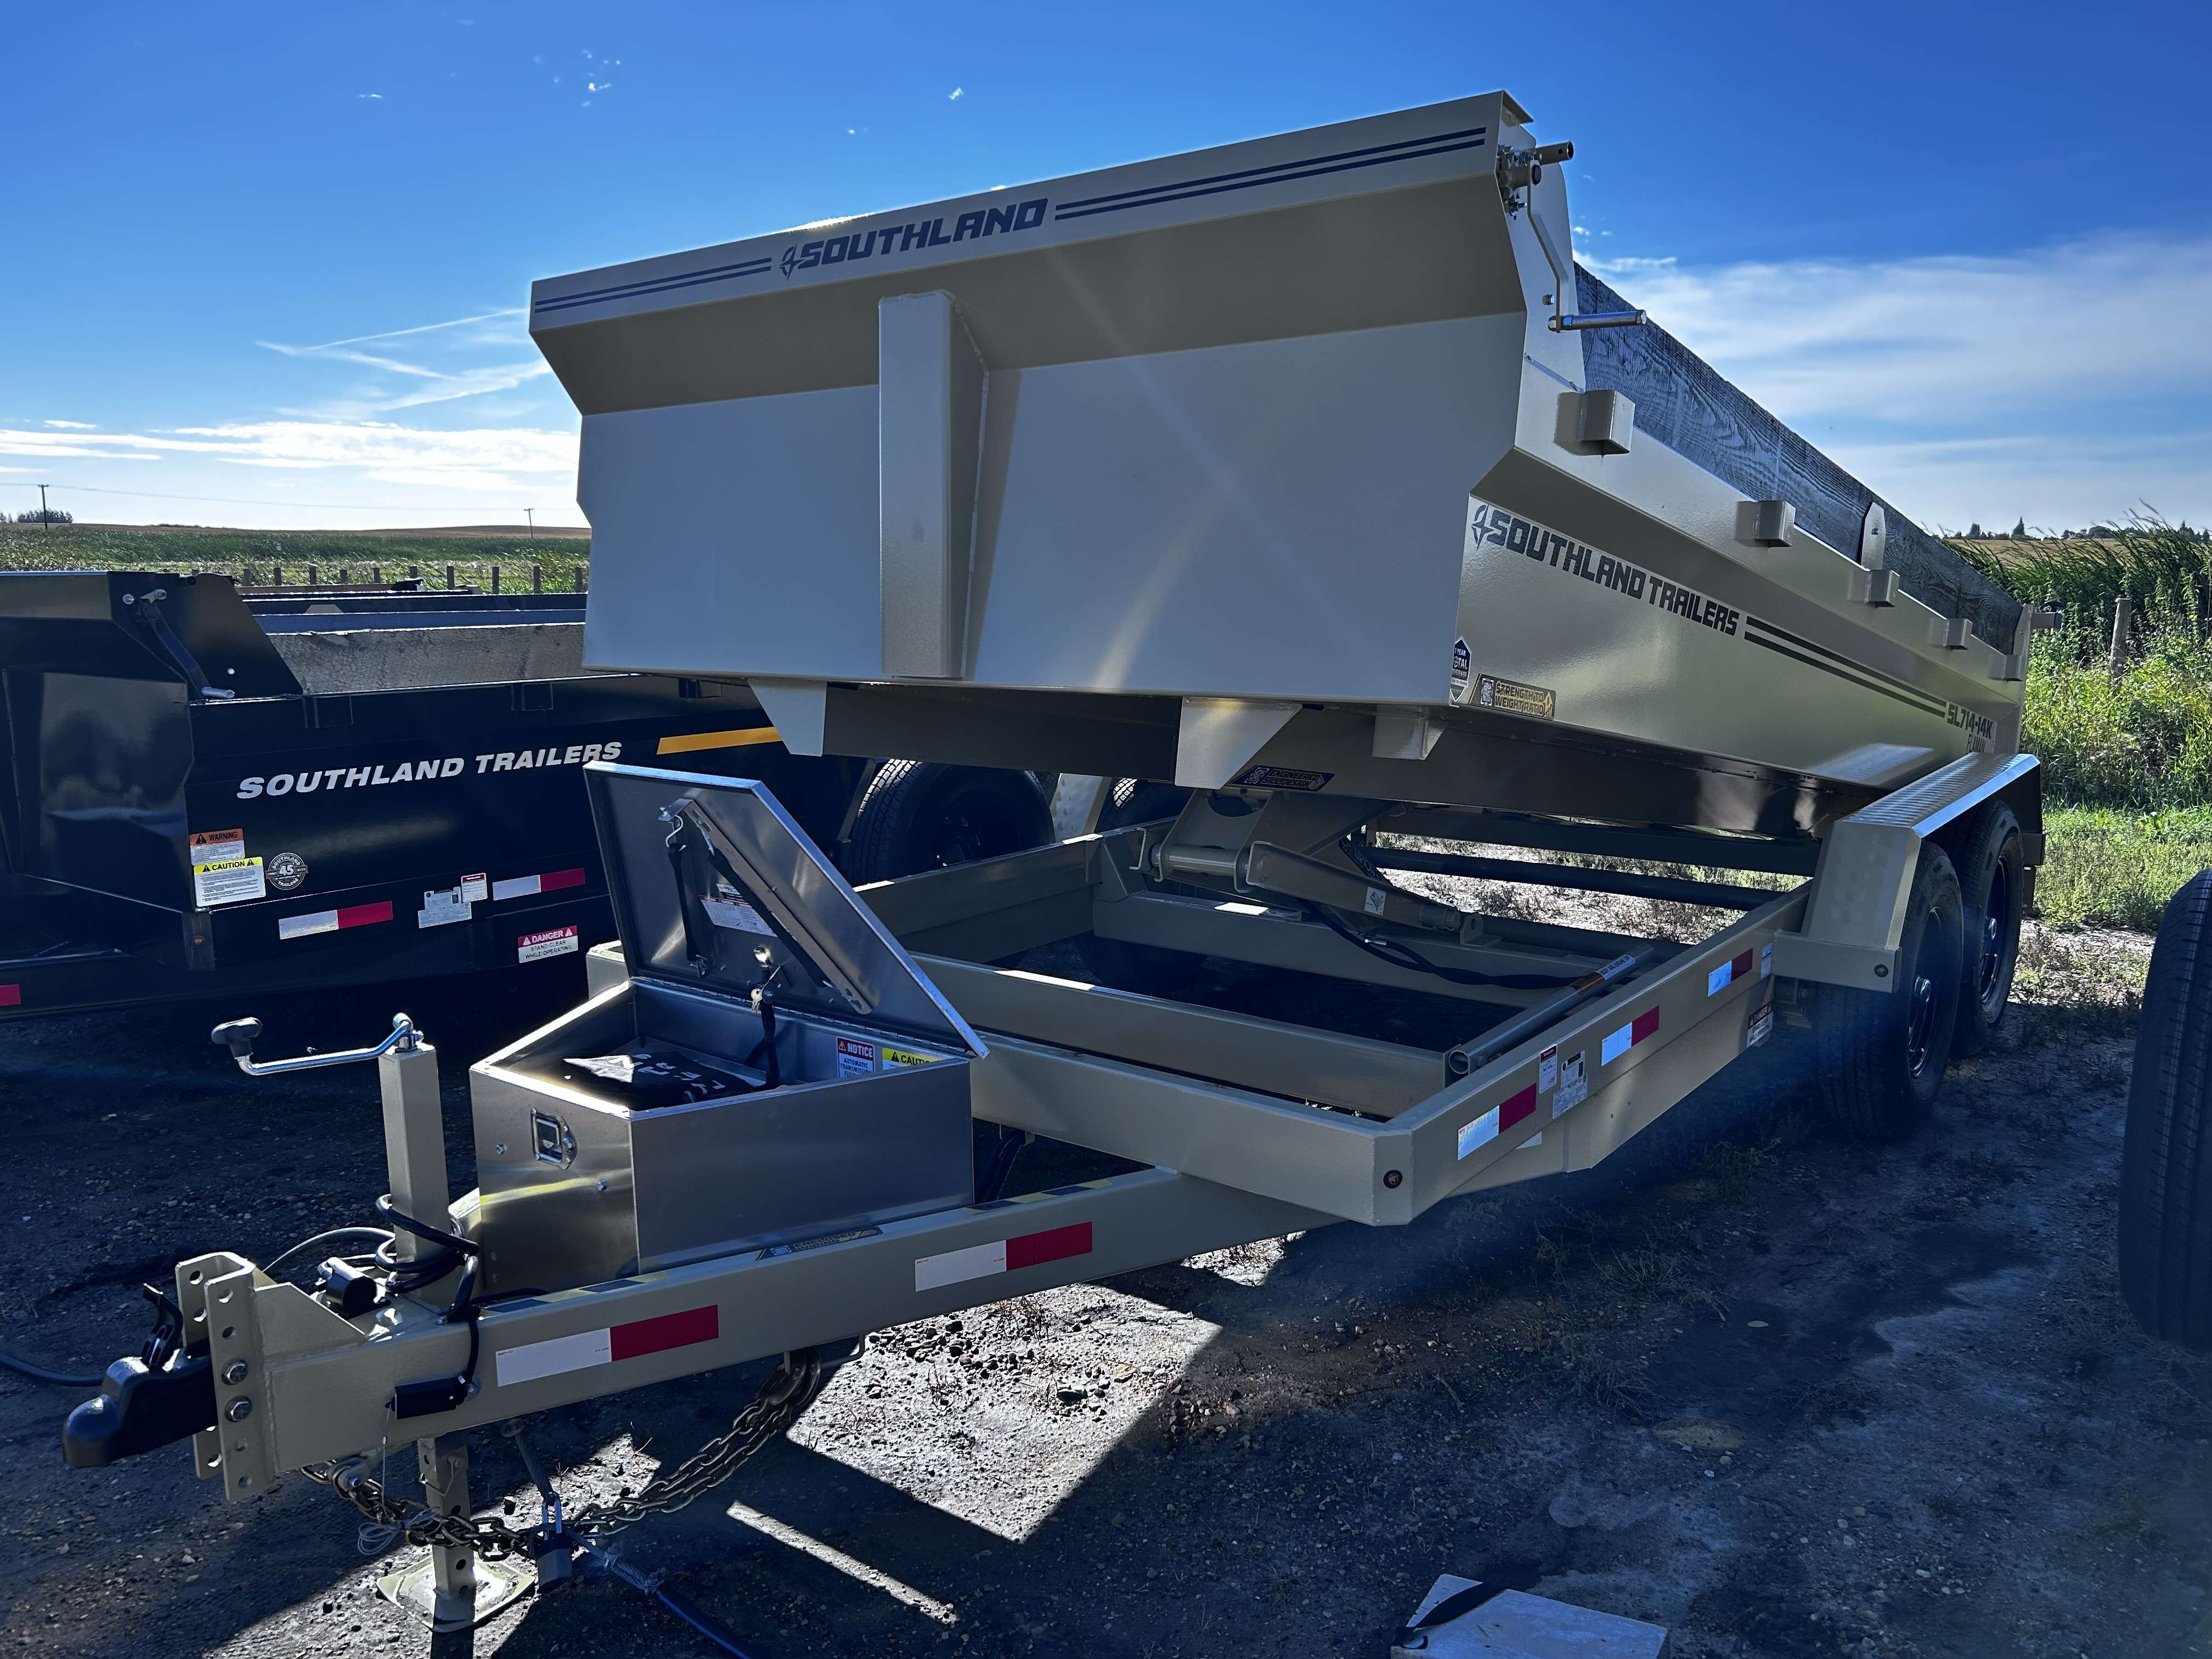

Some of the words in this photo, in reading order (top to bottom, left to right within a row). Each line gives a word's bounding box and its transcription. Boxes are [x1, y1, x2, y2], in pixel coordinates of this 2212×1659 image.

[797, 198, 1048, 269] SOUTHLAND
[1486, 510, 1646, 600] SOUTHLAND
[1648, 576, 1740, 636] TRAILERS
[1496, 681, 1533, 702] STRENGTH
[1533, 691, 1544, 702] TO
[1496, 695, 1523, 712] WEIGHT
[1523, 702, 1545, 715] RATIO
[1947, 704, 1993, 739] SL714-14K
[236, 757, 465, 799] SOUTHLAND
[476, 742, 622, 774] TRAILERS
[1268, 769, 1320, 781] ENGINEERED
[209, 832, 238, 841] WARNING
[212, 861, 245, 871] CAUTION
[279, 864, 294, 876] 45
[532, 930, 563, 943] DANGER
[526, 951, 541, 960] WHILE
[543, 945, 572, 955] OPERATING
[531, 944, 548, 952] STAND
[847, 1042, 873, 1058] NOTICE
[844, 1058, 868, 1069] AUTOMATIC
[901, 1054, 929, 1065] CAUTI
